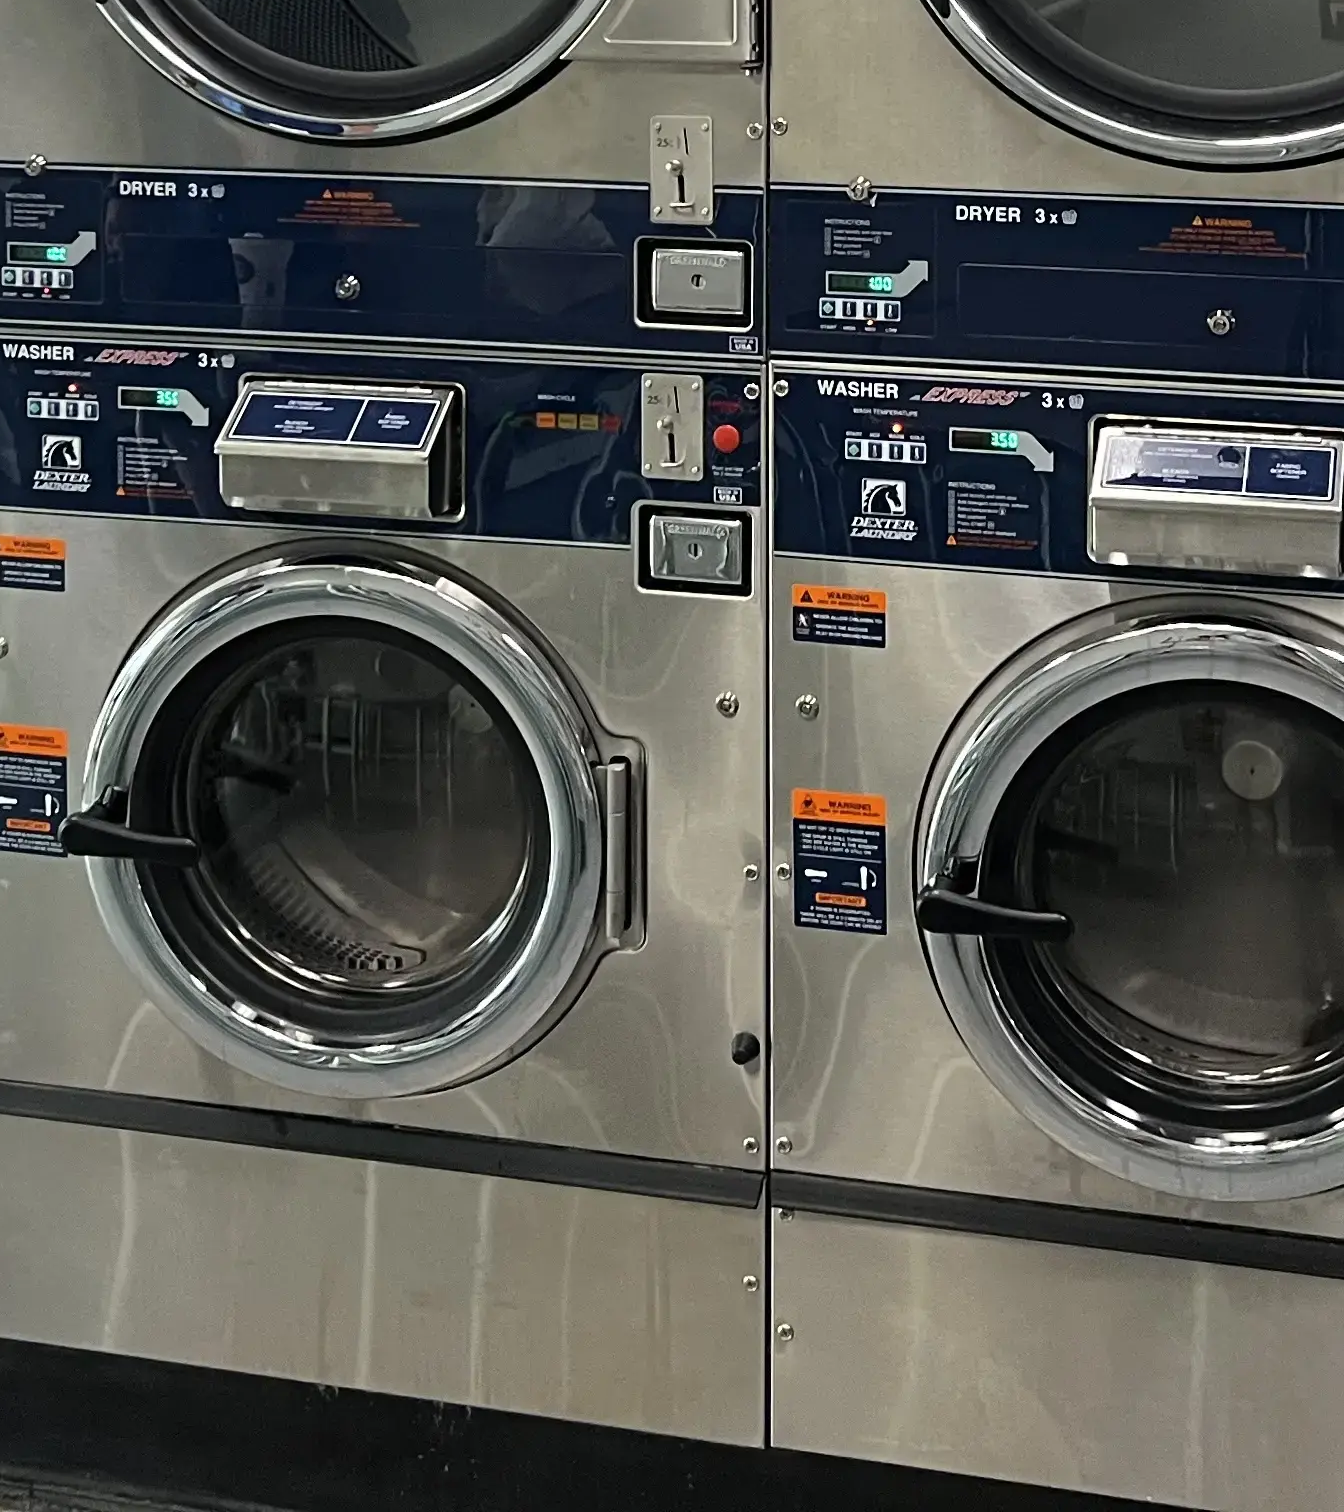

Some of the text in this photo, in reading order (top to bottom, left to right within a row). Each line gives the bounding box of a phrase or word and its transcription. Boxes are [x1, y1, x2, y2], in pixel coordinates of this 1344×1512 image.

[119, 180, 177, 198] DRYER
[956, 205, 1022, 224] DRYER
[1035, 208, 1046, 224] 3
[3, 344, 74, 360] WASHER
[94, 349, 178, 366] EXPRESS
[818, 380, 899, 399] WASHER
[921, 387, 1019, 405] EXPRESS
[1041, 393, 1053, 408] 3
[33, 471, 90, 482] DEXTER
[852, 516, 915, 530] DEXTER
